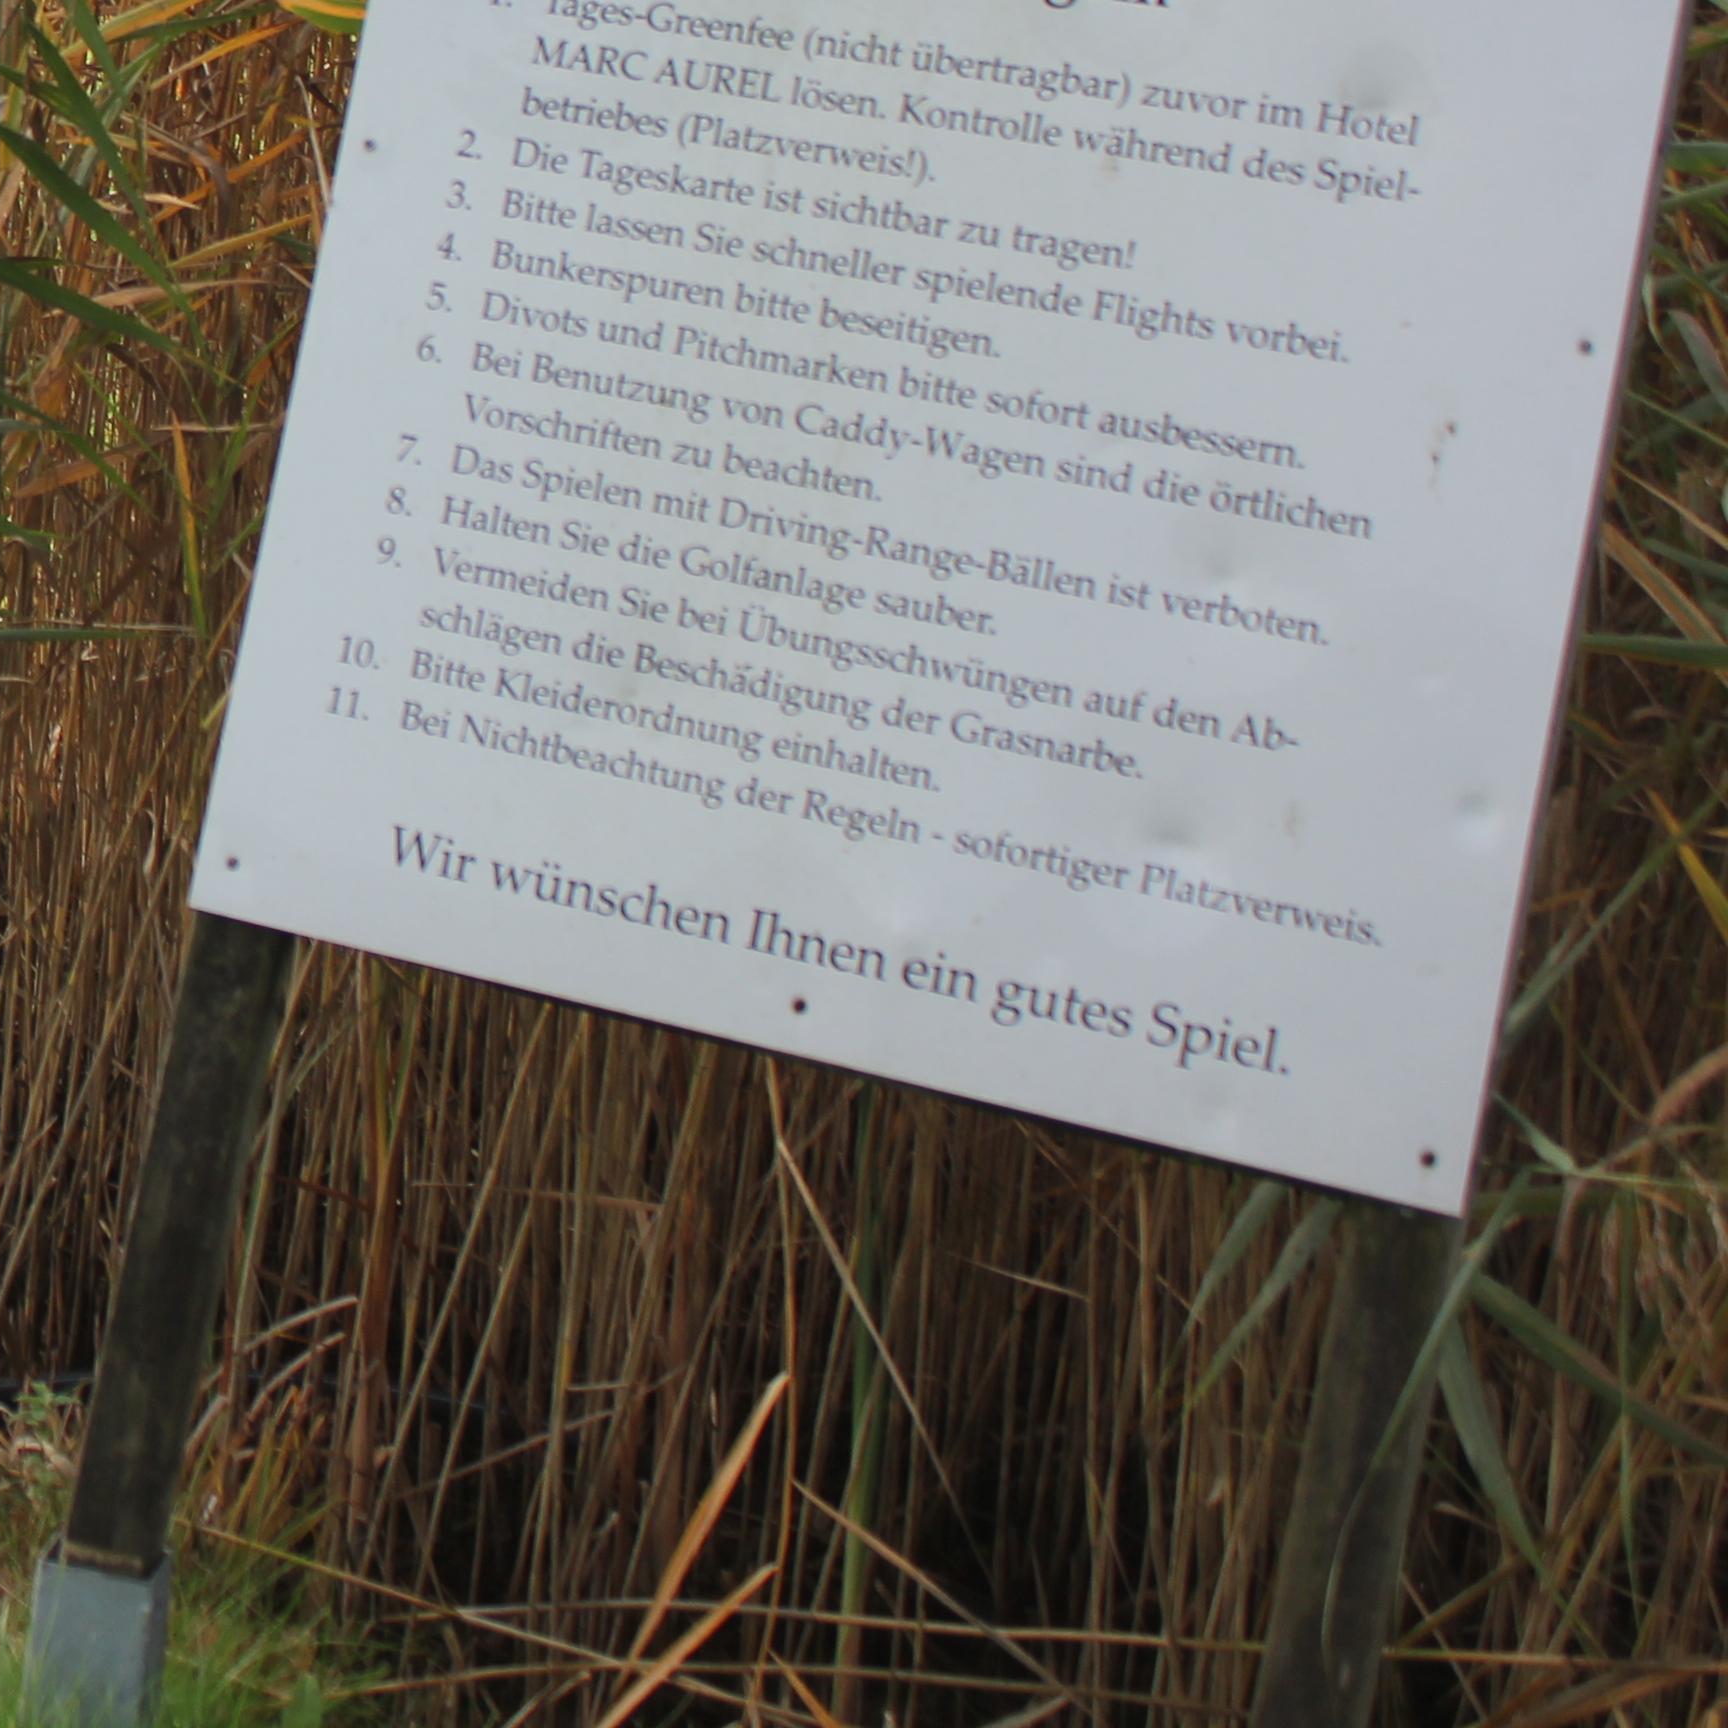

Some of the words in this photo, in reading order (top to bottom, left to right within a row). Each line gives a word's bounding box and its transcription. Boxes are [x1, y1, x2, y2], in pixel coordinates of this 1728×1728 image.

[520, 85, 668, 137] betriebes
[677, 112, 935, 187] (Platzverweis!).
[531, 35, 648, 81] MARC
[652, 57, 781, 102] AUREL
[790, 75, 886, 119] lösen.
[898, 92, 1062, 147] Kontrolle
[1073, 126, 1233, 173] während
[1242, 147, 1306, 185] des
[1313, 157, 1420, 203] Spiel-
[803, 27, 903, 67] (nicht
[911, 41, 1132, 108] übertragbar)
[1140, 84, 1249, 119] zuvor
[1257, 92, 1304, 129] im
[1316, 98, 1420, 146] Hotel
[445, 179, 471, 210] 3.
[501, 187, 576, 228] Bitte
[585, 202, 684, 248] lassen
[692, 222, 744, 258] Sie
[750, 235, 907, 286] schneller
[913, 267, 1083, 316] spielende
[1092, 289, 1215, 340] Flights
[1226, 320, 1348, 363] vorbei.
[456, 128, 482, 159] 2.
[511, 136, 568, 174] Die
[579, 147, 755, 206] Tageskarte
[763, 180, 804, 214] ist
[811, 191, 950, 238] sichtbar
[956, 221, 1000, 248] zu
[1011, 225, 1137, 271] tragen!
[425, 280, 452, 312] 5.
[481, 290, 588, 337] Divots
[597, 320, 664, 352] und
[673, 325, 888, 393] Pitchmarken
[898, 365, 977, 408] bitte
[984, 389, 1090, 429] sofort
[1097, 411, 1304, 469] ausbessern.
[436, 231, 461, 261] 4.
[491, 238, 724, 309] Bunkerspuren
[734, 281, 811, 323] bitte
[819, 296, 1000, 359] beseitigen.
[416, 334, 442, 363] 6.
[471, 341, 523, 378] Bei
[531, 352, 713, 424] Benutzung
[722, 396, 783, 428] von
[793, 403, 1045, 479] Caddy-Wagen
[1054, 455, 1133, 494] sind
[1142, 469, 1201, 506] die
[1209, 480, 1372, 539] örtlichen
[464, 391, 661, 459] Vorschriften
[671, 442, 712, 469] zu
[722, 442, 882, 501] beachten.
[385, 485, 411, 516] 8.
[440, 494, 550, 545] Halten
[559, 520, 610, 556] Sie
[617, 532, 671, 569] die
[679, 544, 867, 614] Golfanlage
[873, 591, 996, 635] sauber.
[397, 432, 421, 465] 7.
[451, 442, 513, 483] Das
[520, 458, 642, 509] Spielen
[652, 490, 710, 522] mit
[718, 496, 1096, 600] Driving-Range-Bällen
[1107, 573, 1151, 610] ist
[1161, 591, 1328, 646] verboten.
[339, 635, 379, 669] 10.
[410, 648, 485, 692] Bitte
[493, 667, 764, 762] Kleiderordnung
[771, 732, 940, 792] einhalten.
[376, 536, 401, 567] 9.
[433, 545, 609, 611] Vermeiden
[618, 586, 669, 623] Sie
[677, 596, 728, 635] bei
[738, 605, 1073, 708] Übungsschwüngen
[1083, 689, 1148, 722] auf
[1152, 696, 1221, 738] den
[1230, 712, 1299, 751] Ab-
[419, 603, 562, 656] schlägen
[571, 631, 625, 668] die
[633, 642, 873, 730] Beschädigung
[881, 696, 942, 735] der
[949, 710, 1143, 779] Grasnarbe.
[326, 685, 368, 721] 11.
[400, 699, 451, 739] Bei
[459, 712, 726, 809] Nichtbeachtung
[734, 776, 794, 814] der
[801, 788, 921, 843] Regeln
[953, 831, 1130, 891] sofortiger
[1140, 863, 1382, 947] Platzverweis.
[393, 823, 477, 882] Wir
[490, 860, 730, 944] wünschen
[745, 907, 886, 981] Ihnen
[900, 951, 977, 1002] ein
[990, 979, 1133, 1037] gutes
[1146, 1001, 1289, 1075] Spiel.
